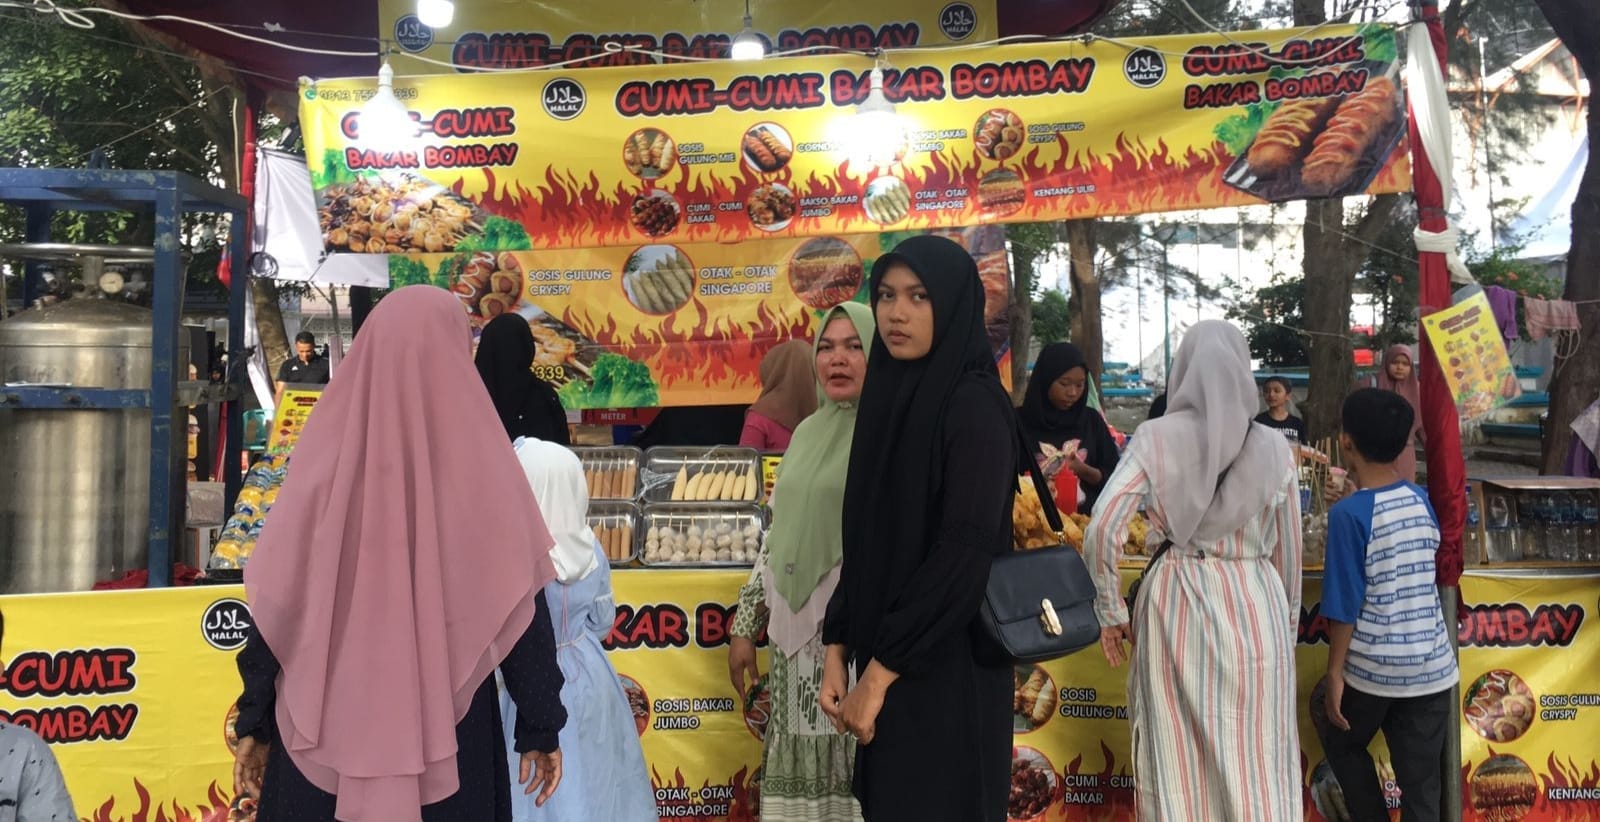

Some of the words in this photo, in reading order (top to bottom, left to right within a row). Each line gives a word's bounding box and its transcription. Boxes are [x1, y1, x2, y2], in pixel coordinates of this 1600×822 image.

[1185, 37, 1364, 75] CUMI-CUMI
[1128, 57, 1162, 75] حلال
[1132, 72, 1160, 81] HALAL
[617, 77, 823, 114] CUMI-CUMI
[952, 58, 1095, 99] BOMBAY
[1185, 83, 1260, 108] BAKAR
[1266, 69, 1367, 100] BOMBAY
[545, 86, 582, 104] حلال
[550, 104, 578, 113] HALAL
[940, 129, 967, 139] BAKAR
[1028, 124, 1050, 134] SOSIS
[1052, 122, 1085, 132] GULUNG
[1028, 133, 1057, 144] CRYSPY
[678, 143, 704, 153] SOSIS
[424, 144, 518, 167] BOMBAY
[679, 154, 717, 164] GULUNG
[719, 153, 736, 162] MIE
[914, 190, 938, 200] OTAK
[945, 188, 968, 198] OTAK
[1033, 186, 1074, 197] KENTANG
[800, 197, 828, 206] BAKSO
[831, 196, 858, 205] BAKAR
[915, 200, 965, 211] SINGAPORE
[686, 204, 711, 213] CUMI
[718, 202, 743, 211] CUMI
[800, 207, 831, 217] JUMBO
[687, 214, 716, 224] BAKAR
[528, 269, 562, 281] SOSIS
[564, 268, 612, 281] GULUNG
[700, 267, 730, 280] OTAK
[744, 265, 777, 279] OTAK
[529, 283, 571, 296] CRYSPY
[700, 281, 773, 296] SINGAPORE
[207, 609, 250, 630] حلال
[211, 630, 245, 641] HALAL
[1061, 688, 1096, 700] SOSIS
[654, 699, 692, 712] SOSIS
[693, 698, 734, 711] BAKAR
[1541, 695, 1568, 706] SOSIS
[1061, 705, 1114, 718] GULUNG
[1541, 708, 1577, 720] CRYSPY
[654, 717, 699, 729] JUMBO
[1065, 775, 1098, 787] CUMI
[1110, 776, 1136, 788] CUM
[655, 788, 688, 800] OTAK
[700, 787, 733, 799] OTAK
[1065, 791, 1104, 804] BAKAR
[1548, 787, 1600, 800] KENTANG
[656, 804, 728, 817] SINGAPORE
